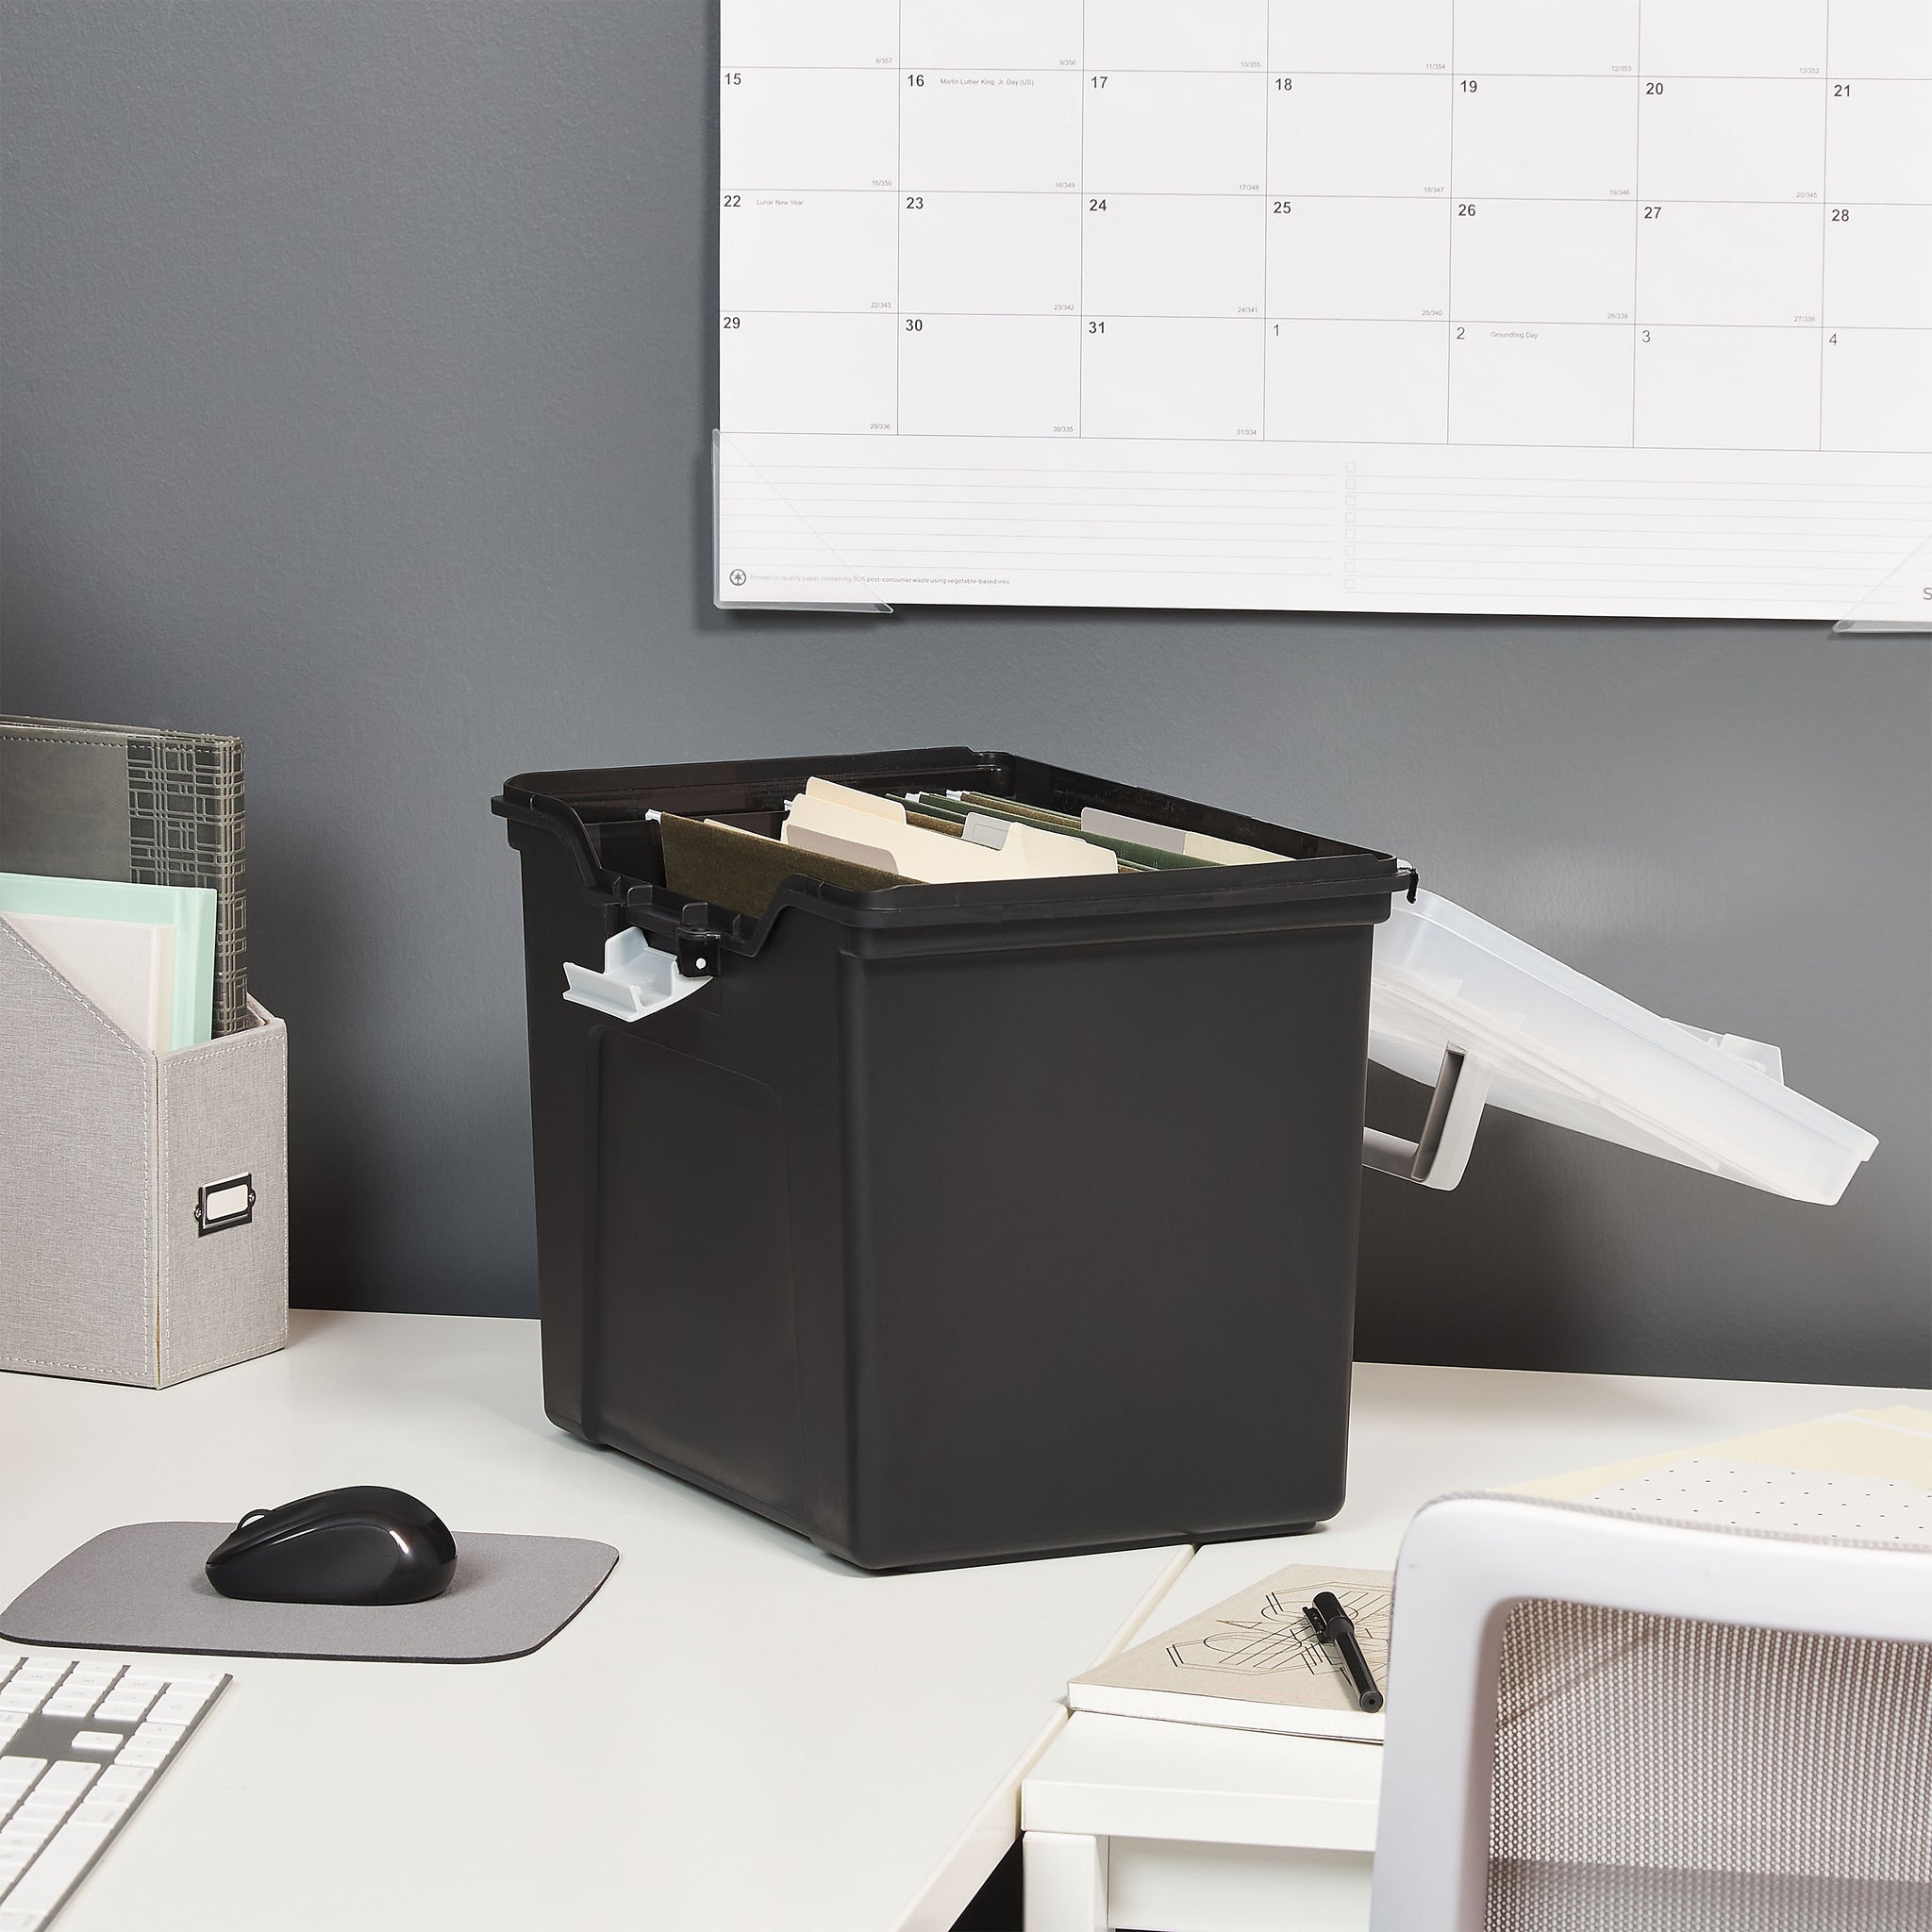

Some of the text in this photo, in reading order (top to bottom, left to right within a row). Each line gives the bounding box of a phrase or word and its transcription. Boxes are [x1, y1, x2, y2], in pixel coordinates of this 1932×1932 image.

[724, 72, 741, 86] 15
[908, 74, 924, 88] 16
[1006, 79, 1019, 88] Day
[1091, 75, 1108, 89] 17
[1274, 77, 1292, 92] 18
[1460, 79, 1478, 93] 19
[1645, 82, 1664, 95] 20
[1833, 84, 1850, 97] 21
[724, 194, 741, 208] 22
[906, 196, 924, 209] 23
[1089, 198, 1108, 212] 24
[1274, 201, 1291, 214] 25
[1457, 203, 1476, 217] 26
[1643, 206, 1662, 220] 27
[1831, 208, 1850, 223] 28
[723, 316, 741, 329] 29
[906, 319, 924, 332] 30
[1089, 321, 1105, 334] 31
[1274, 324, 1279, 337] 1
[1457, 326, 1465, 341] 2
[1490, 331, 1538, 340] Groundhog Day
[1641, 329, 1651, 343] 3
[1828, 333, 1838, 346] 4
[947, 577, 997, 586] vegetable-based
